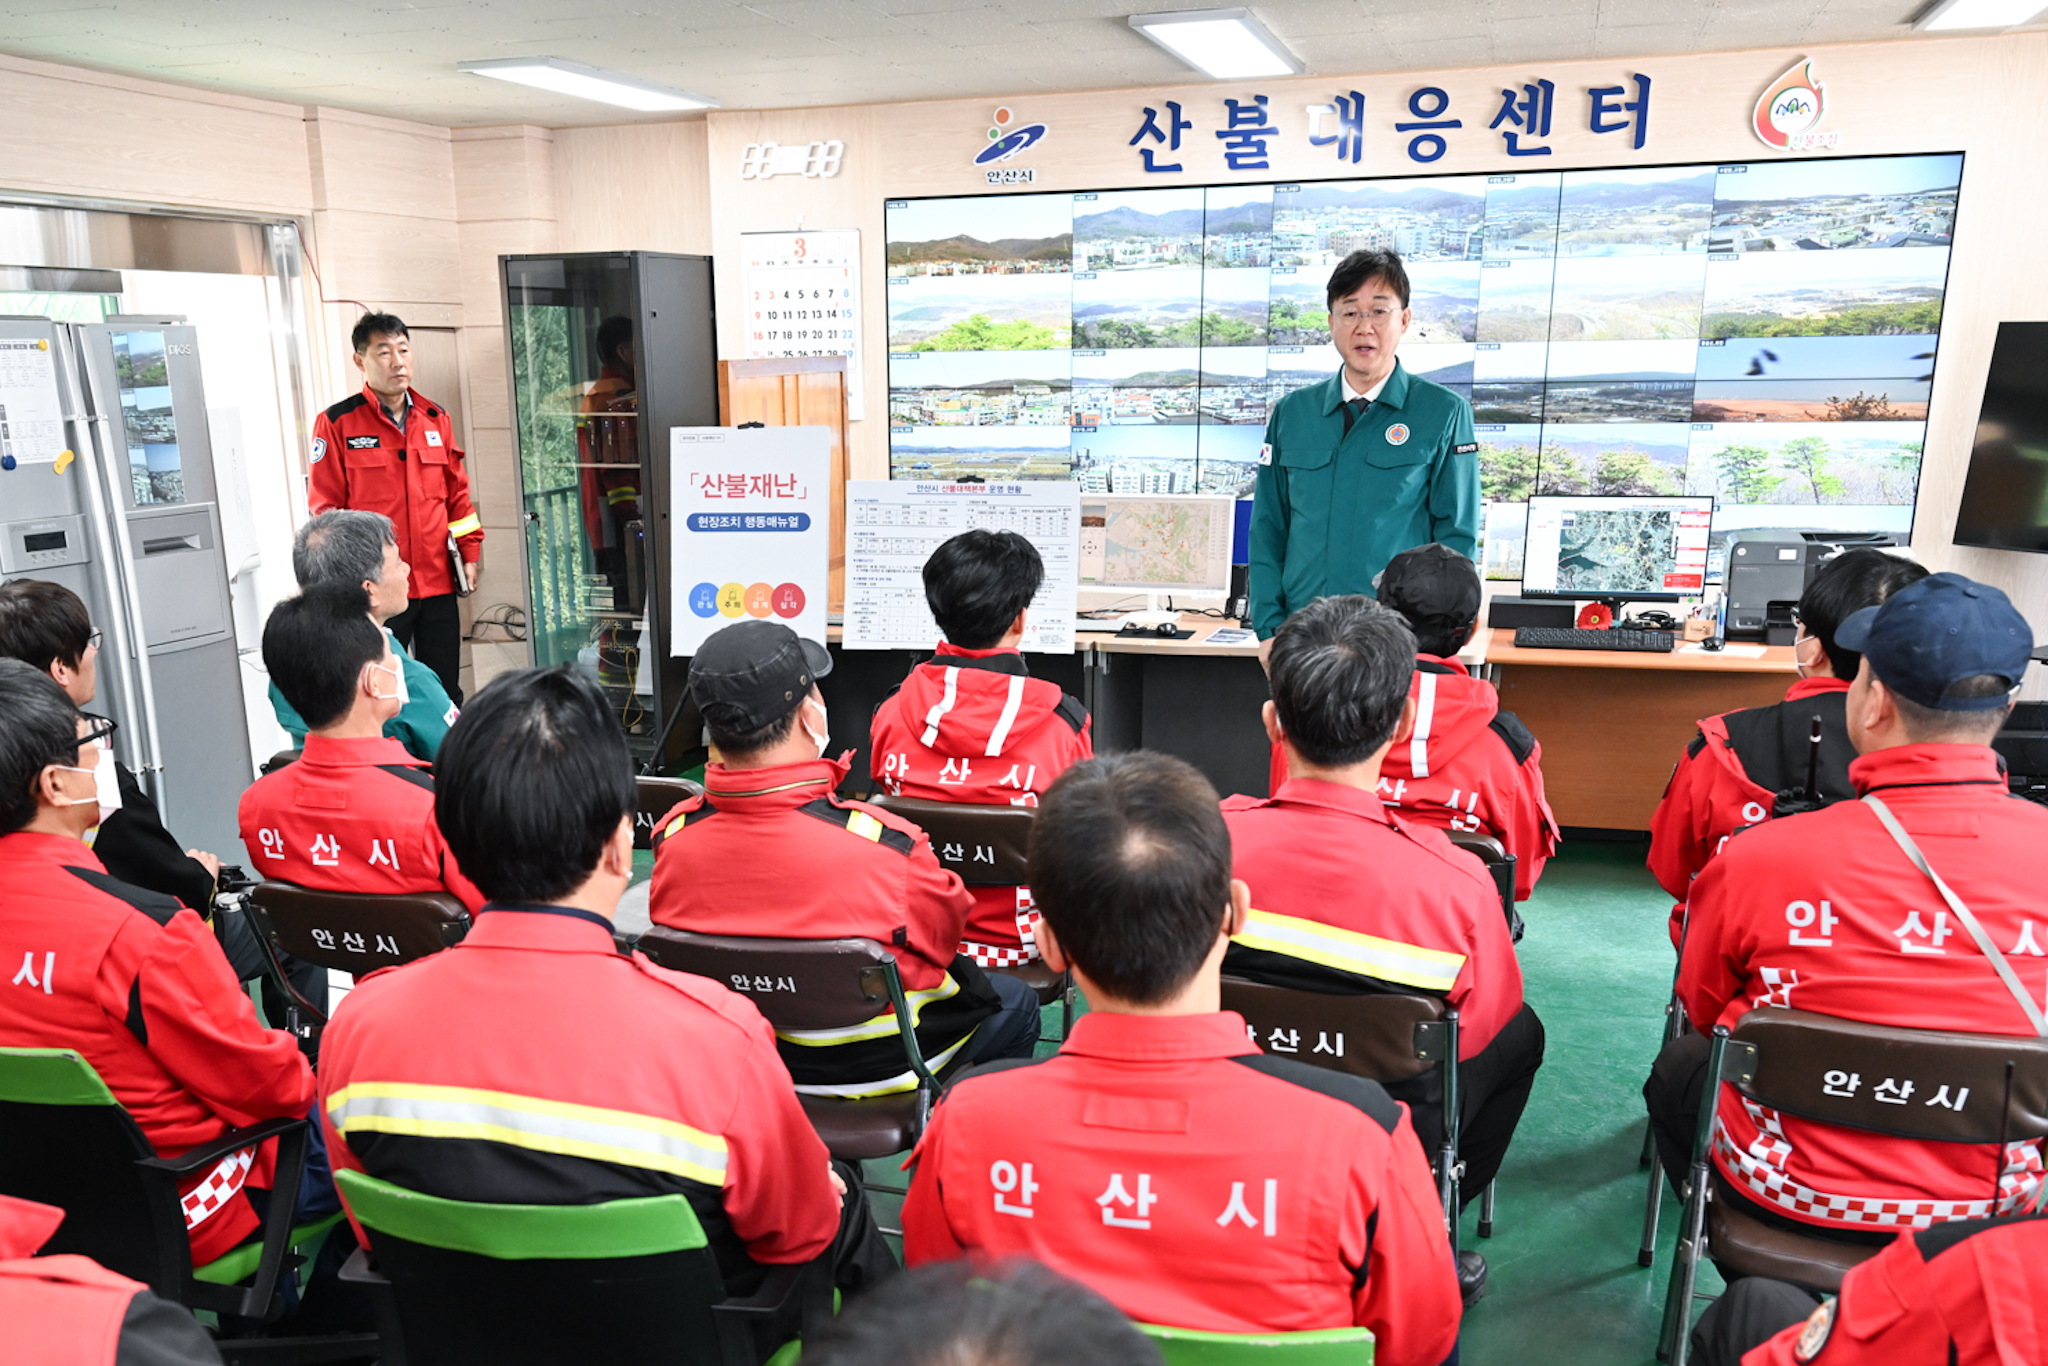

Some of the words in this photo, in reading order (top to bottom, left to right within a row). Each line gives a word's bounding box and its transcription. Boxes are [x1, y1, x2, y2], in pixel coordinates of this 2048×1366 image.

[1129, 72, 1652, 172] 산불대응센터
[987, 170, 1032, 183] 안산시
[794, 237, 806, 258] 3
[844, 268, 848, 277] 1
[754, 291, 760, 300] 2
[769, 291, 775, 300] 3
[783, 290, 789, 299] 4
[798, 290, 804, 299] 5
[813, 290, 819, 299] 6
[828, 289, 834, 298] 7
[843, 289, 849, 298] 8
[755, 311, 761, 320] 9
[768, 311, 777, 320] 10
[783, 311, 792, 319] 11
[797, 310, 807, 319] 12
[812, 310, 822, 319] 13
[827, 309, 837, 318] 14
[842, 309, 852, 318] 15
[753, 331, 763, 340] 16
[768, 331, 777, 340] 17
[783, 330, 792, 340] 18
[797, 330, 807, 339] 19
[812, 330, 822, 339] 20
[827, 330, 837, 339] 21
[842, 329, 853, 339] 22
[916, 484, 939, 493] 안산시
[698, 516, 741, 529] 현장조치
[744, 516, 800, 529] 행동매뉴얼
[697, 601, 714, 609] 관심
[725, 601, 741, 609] 주의
[752, 601, 769, 609] 경계
[780, 601, 797, 609] 심각
[258, 828, 400, 871] 안산시
[928, 842, 995, 864] 산시
[311, 928, 400, 955] 안산시
[12, 951, 55, 995] 시
[731, 974, 797, 993] 안산시
[1822, 1069, 1970, 1112] 안산시
[989, 1159, 1278, 1237] 안산시
